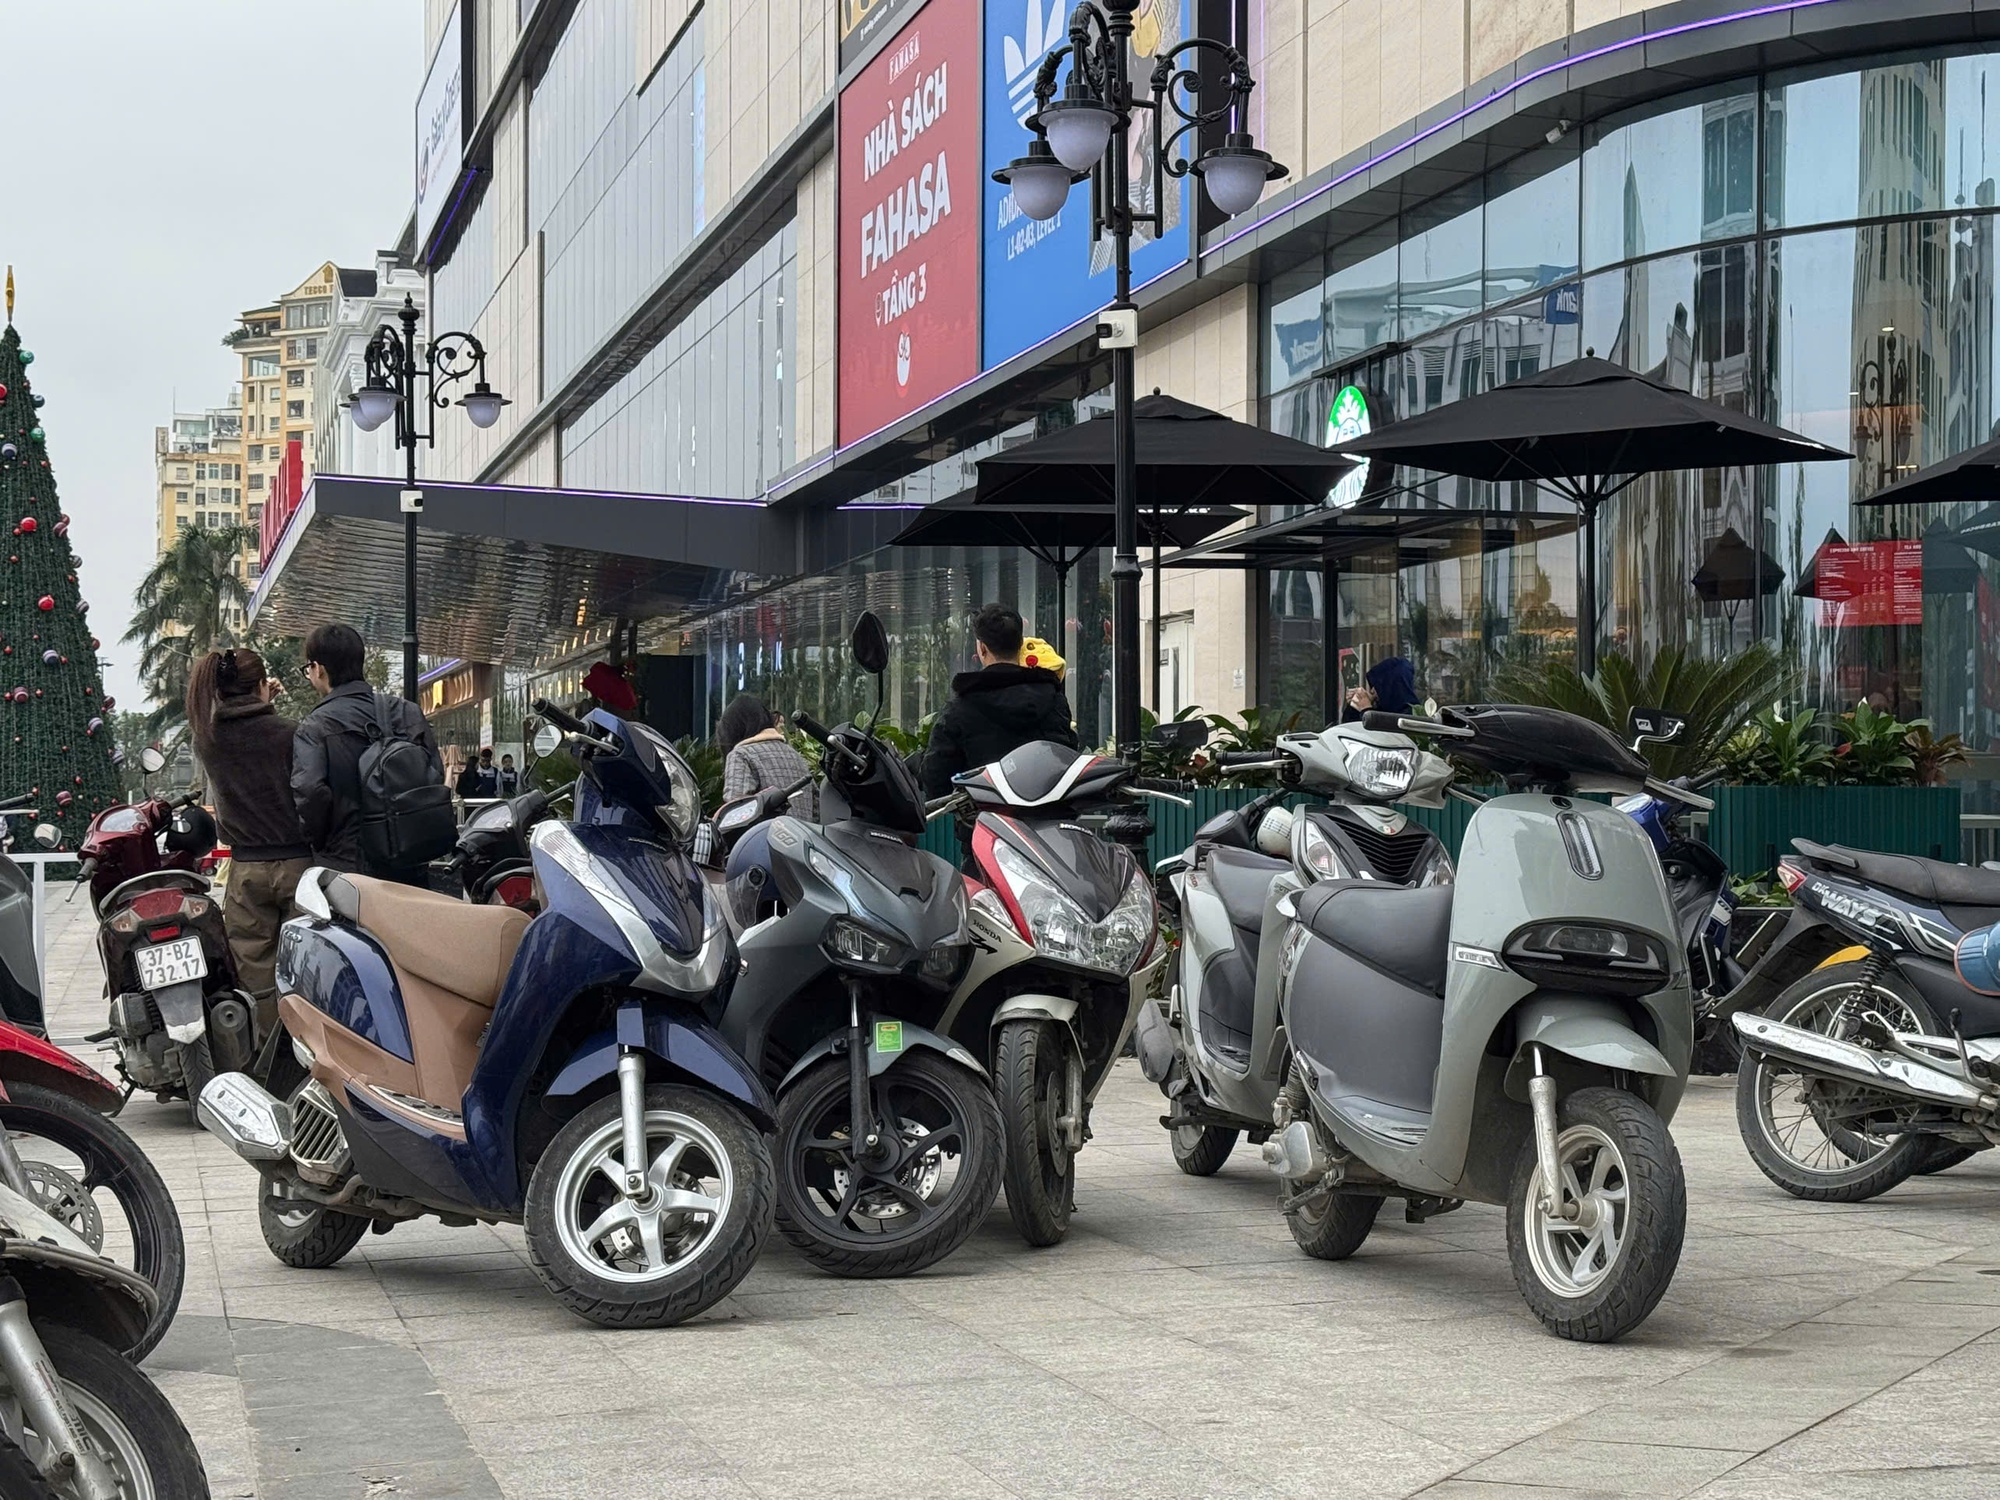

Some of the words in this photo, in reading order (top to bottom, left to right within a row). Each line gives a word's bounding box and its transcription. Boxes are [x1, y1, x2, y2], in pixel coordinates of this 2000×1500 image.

[889, 36, 919, 81] FAHASA
[864, 99, 898, 182] NHÀ
[901, 61, 947, 149] SÁCH
[861, 151, 951, 279] FAHASA
[304, 285, 327, 295] TECCO
[882, 269, 915, 325] TẦNG
[918, 262, 926, 302] 3
[1812, 882, 1829, 894] DK
[1821, 890, 1884, 927] WAYS
[973, 919, 1002, 943] HONDA
[146, 942, 193, 967] 37-B2
[145, 958, 200, 987] 732.17
